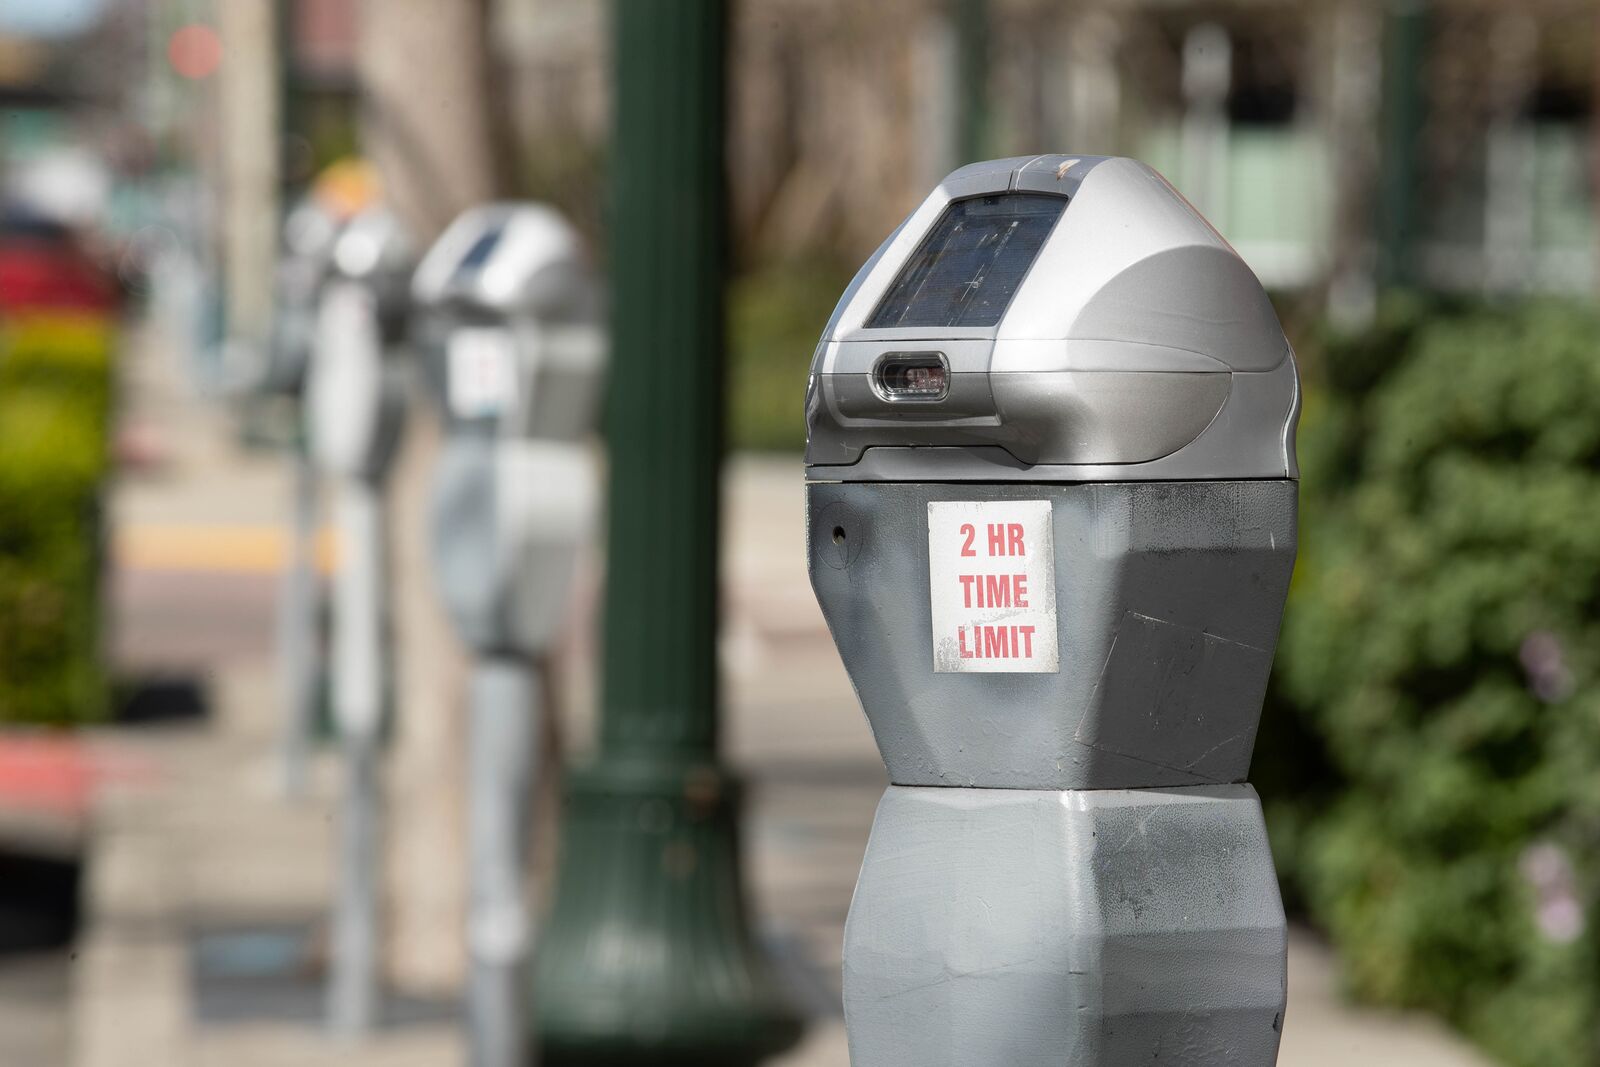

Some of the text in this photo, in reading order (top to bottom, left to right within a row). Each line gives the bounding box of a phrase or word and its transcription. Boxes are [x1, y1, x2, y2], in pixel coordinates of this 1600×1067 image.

[960, 523, 1026, 557] 2 HR
[958, 574, 1029, 608] TIME
[958, 625, 1036, 659] LIMIT
